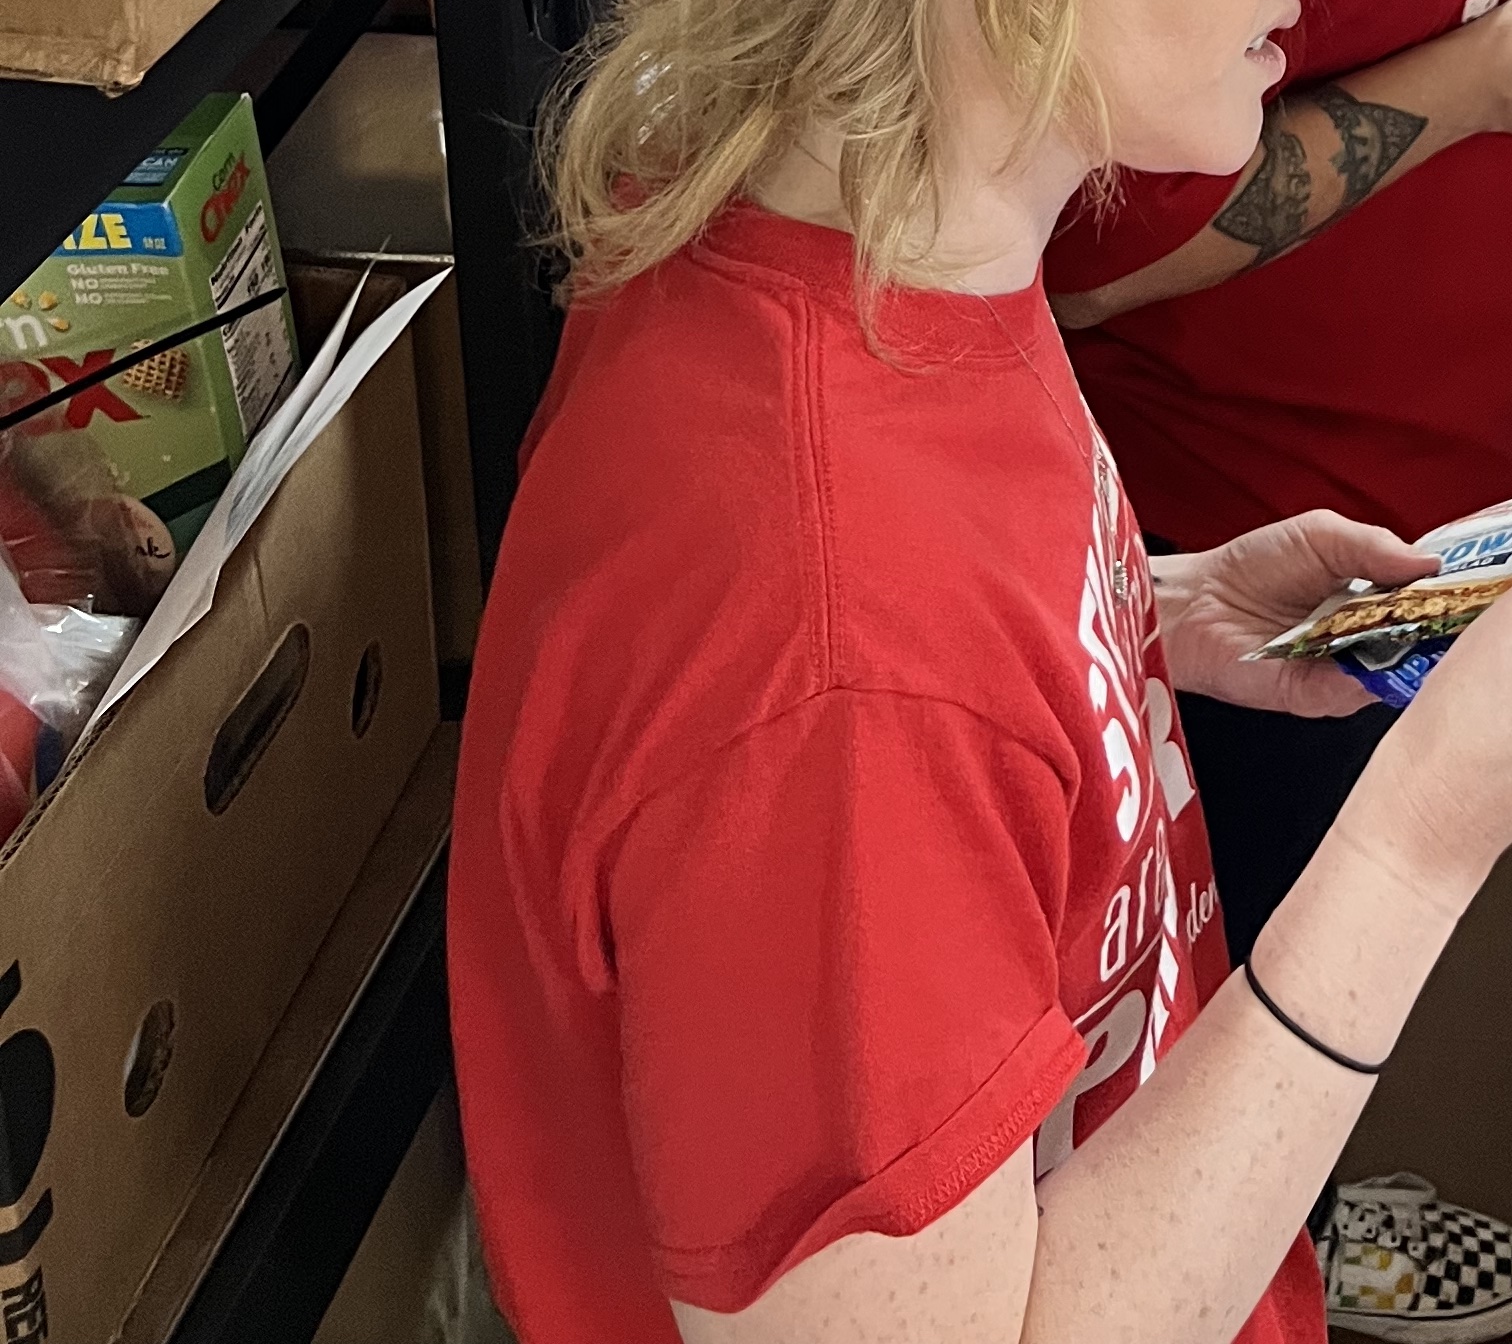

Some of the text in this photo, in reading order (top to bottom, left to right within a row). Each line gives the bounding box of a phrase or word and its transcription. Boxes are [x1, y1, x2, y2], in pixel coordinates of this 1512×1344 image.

[66, 263, 170, 276] Gluten Free
[70, 277, 100, 291] NO
[75, 292, 103, 305] NO
